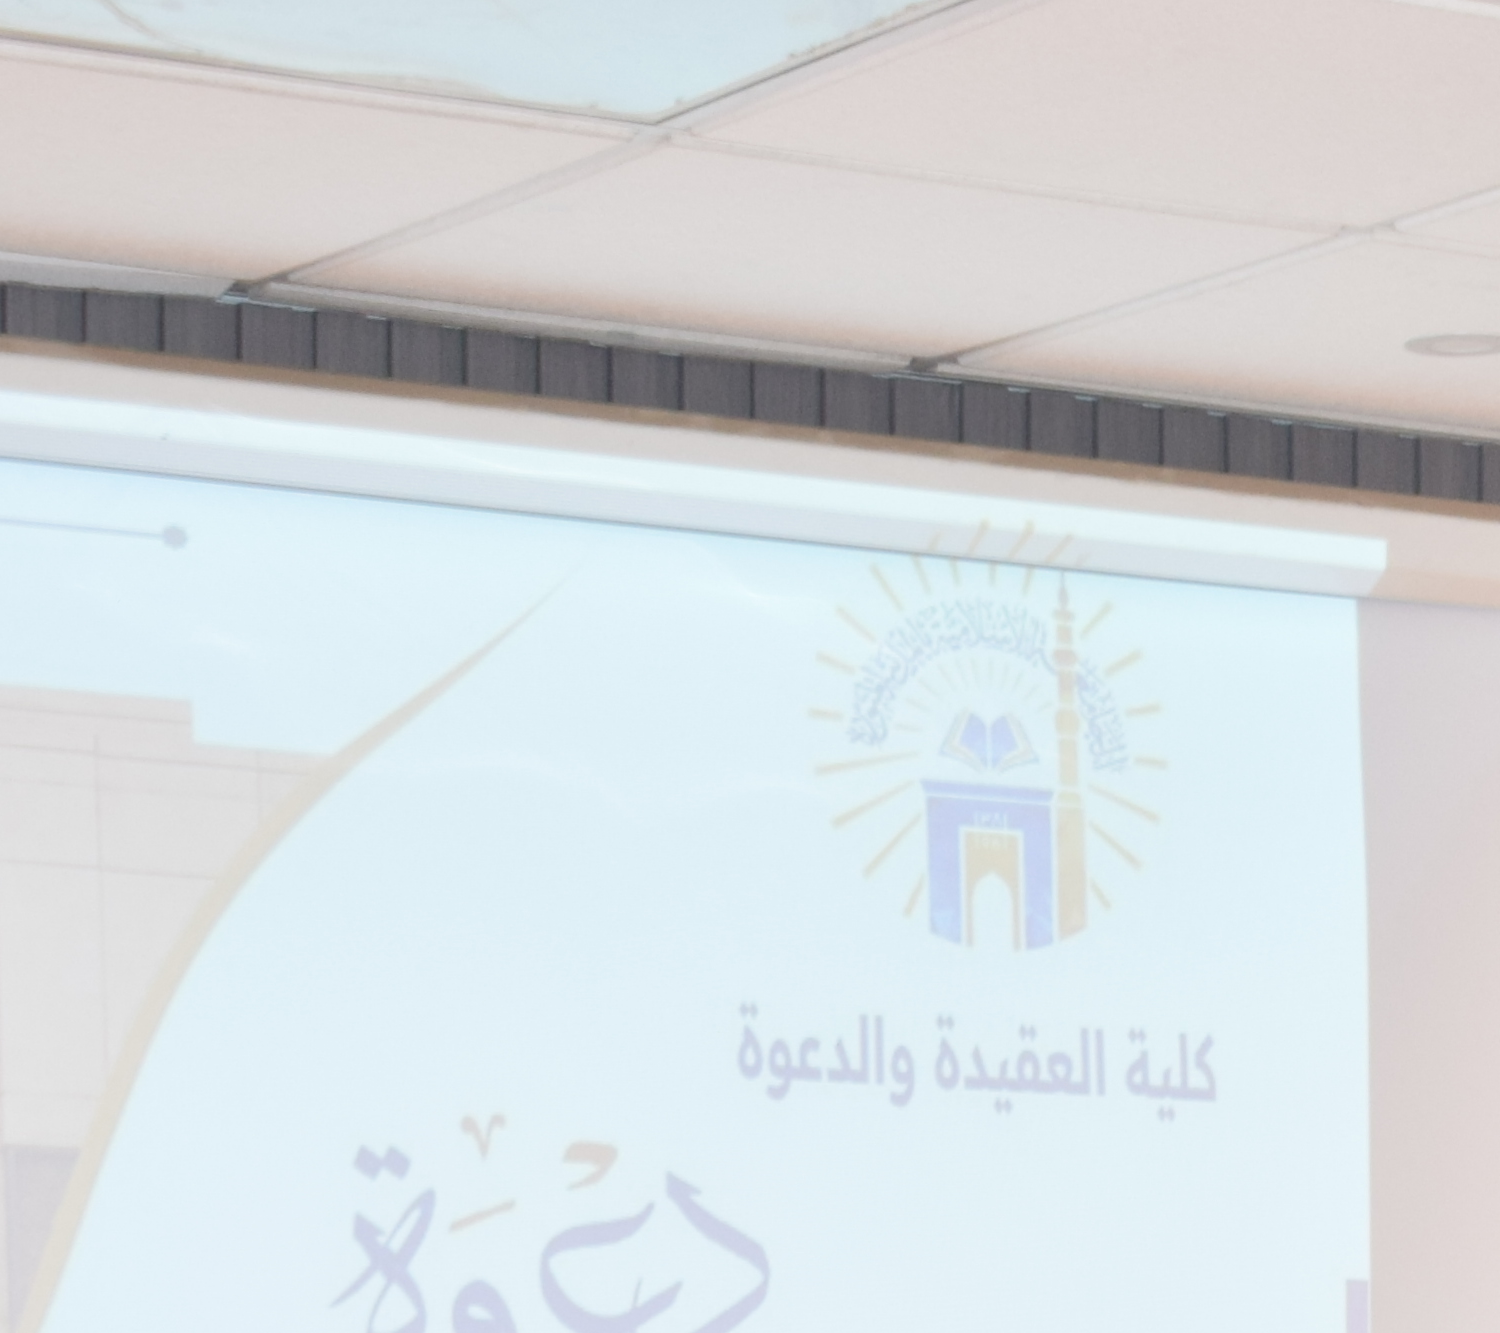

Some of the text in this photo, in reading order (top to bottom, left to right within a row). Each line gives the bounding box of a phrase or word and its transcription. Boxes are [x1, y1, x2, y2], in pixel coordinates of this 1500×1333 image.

[737, 1001, 1218, 1122] كلية العقيدة والدعوة
